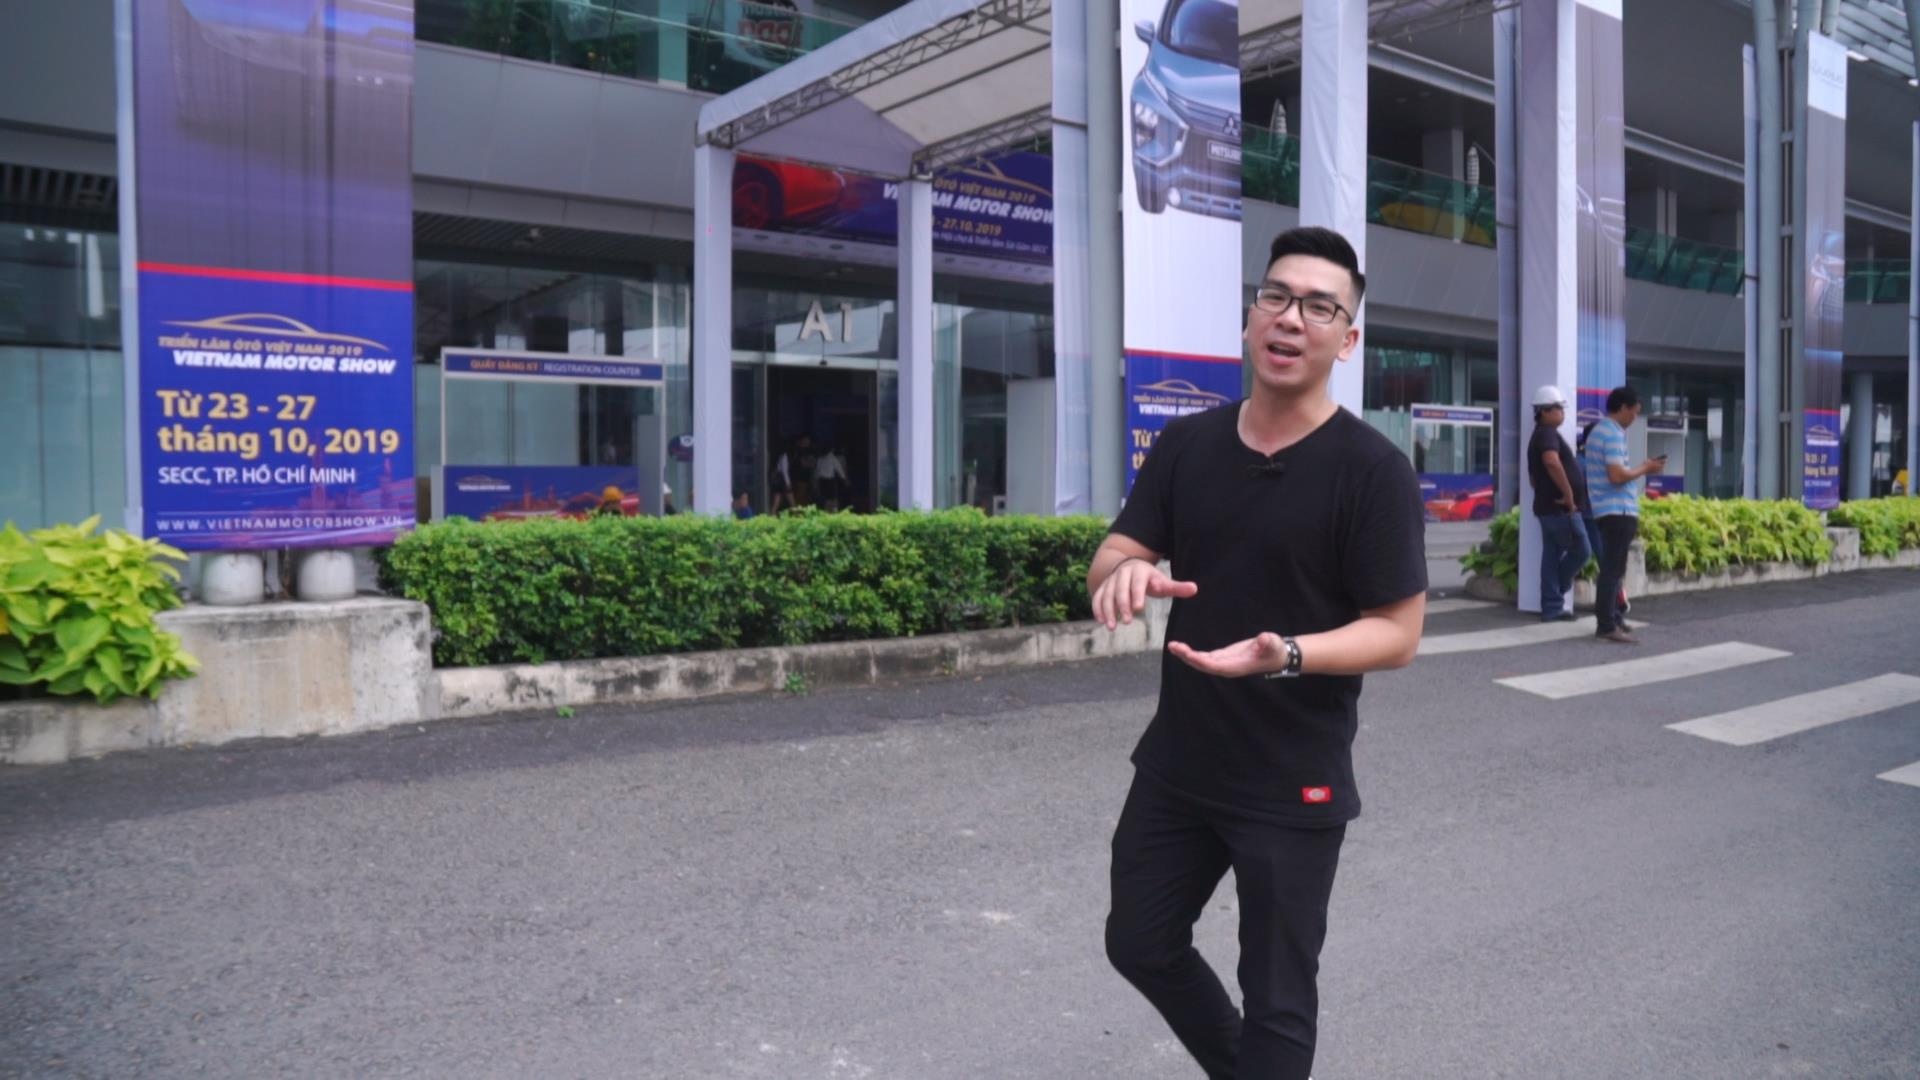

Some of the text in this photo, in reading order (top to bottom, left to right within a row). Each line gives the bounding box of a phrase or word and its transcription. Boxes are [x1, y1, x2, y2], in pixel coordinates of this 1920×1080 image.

[953, 198, 1011, 218] MOTOR
[975, 221, 1002, 236] 2019
[798, 301, 852, 342] A1
[158, 333, 199, 349] TRIỂN
[265, 340, 293, 354] VIỆT
[294, 343, 325, 355] NAM
[328, 345, 363, 356] 2019
[173, 350, 396, 374] VIETNAM MOTOR SHOW
[543, 362, 602, 375] REGISTRATION
[602, 365, 641, 376] COUNTER
[156, 389, 202, 418] Từ
[208, 393, 249, 419] 23
[277, 395, 316, 421] 27
[1139, 403, 1177, 416] VIETNAM
[157, 424, 399, 460] tháng 10, 2019
[158, 463, 356, 486] SECC, TP. HỒ CHÍ MINH
[156, 516, 403, 531] WWW.VIETNAMMOTORSHOW.VN
